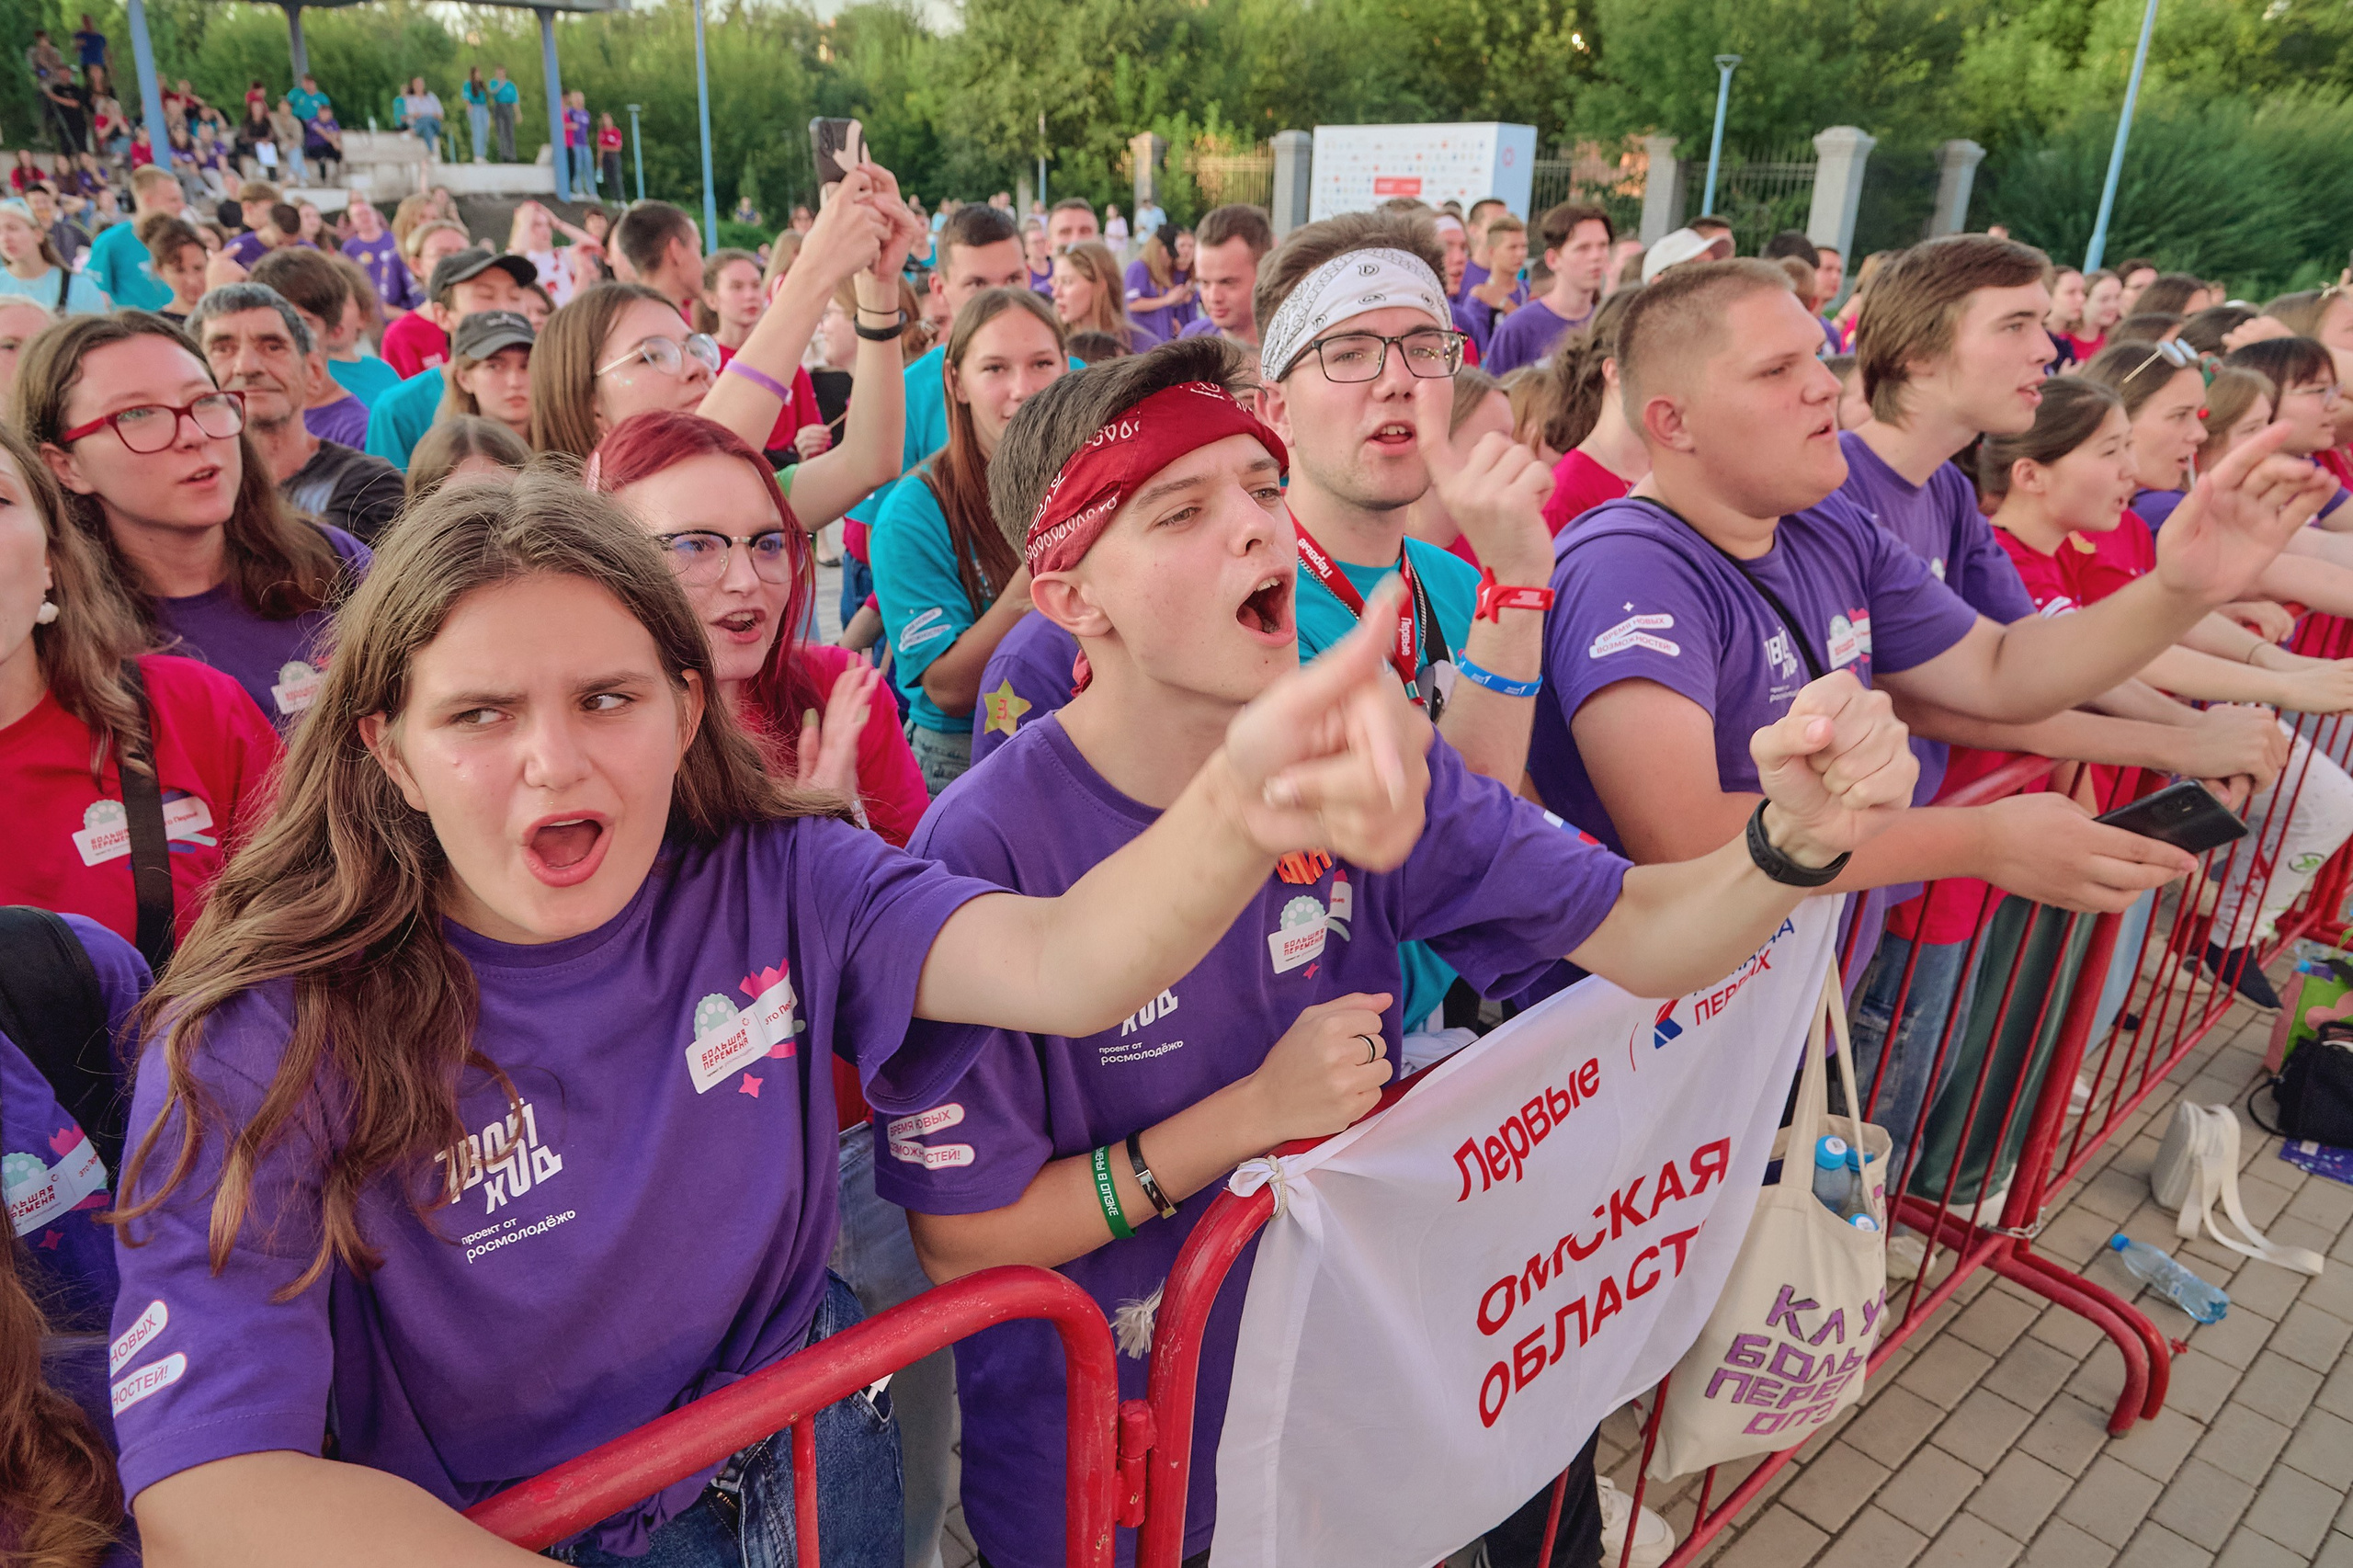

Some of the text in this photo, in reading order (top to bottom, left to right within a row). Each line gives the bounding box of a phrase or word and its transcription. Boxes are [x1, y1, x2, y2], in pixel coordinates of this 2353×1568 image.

[1297, 538, 1334, 579] Первые
[1398, 616, 1413, 656] Первые
[1283, 927, 1325, 949] БОЛЬШАЯ
[1283, 934, 1324, 957] ПЕРЕМЕНА
[701, 1028, 747, 1062] БОЛЬШАЯ
[702, 1037, 749, 1071] ПЕРЕМЕНА
[1098, 1041, 1143, 1055] проект от
[1100, 1040, 1184, 1066] росмолодёжь
[1452, 1057, 1600, 1203] Первые
[483, 1137, 563, 1215] ХОД
[1097, 1172, 1108, 1181] В
[10, 1184, 55, 1212] ЛЬШАЯ
[10, 1192, 57, 1219] РЕМЕНА
[460, 1217, 518, 1245] проект от
[465, 1209, 576, 1265] росмолодёжь
[1476, 1136, 1731, 1336] ОМСКАЯ
[1478, 1219, 1707, 1429] ОБЛАСТ
[1765, 1283, 1887, 1346] КЛУ
[110, 1313, 157, 1368] НОВЫХ
[112, 1364, 169, 1406] НОСТЕЙ!
